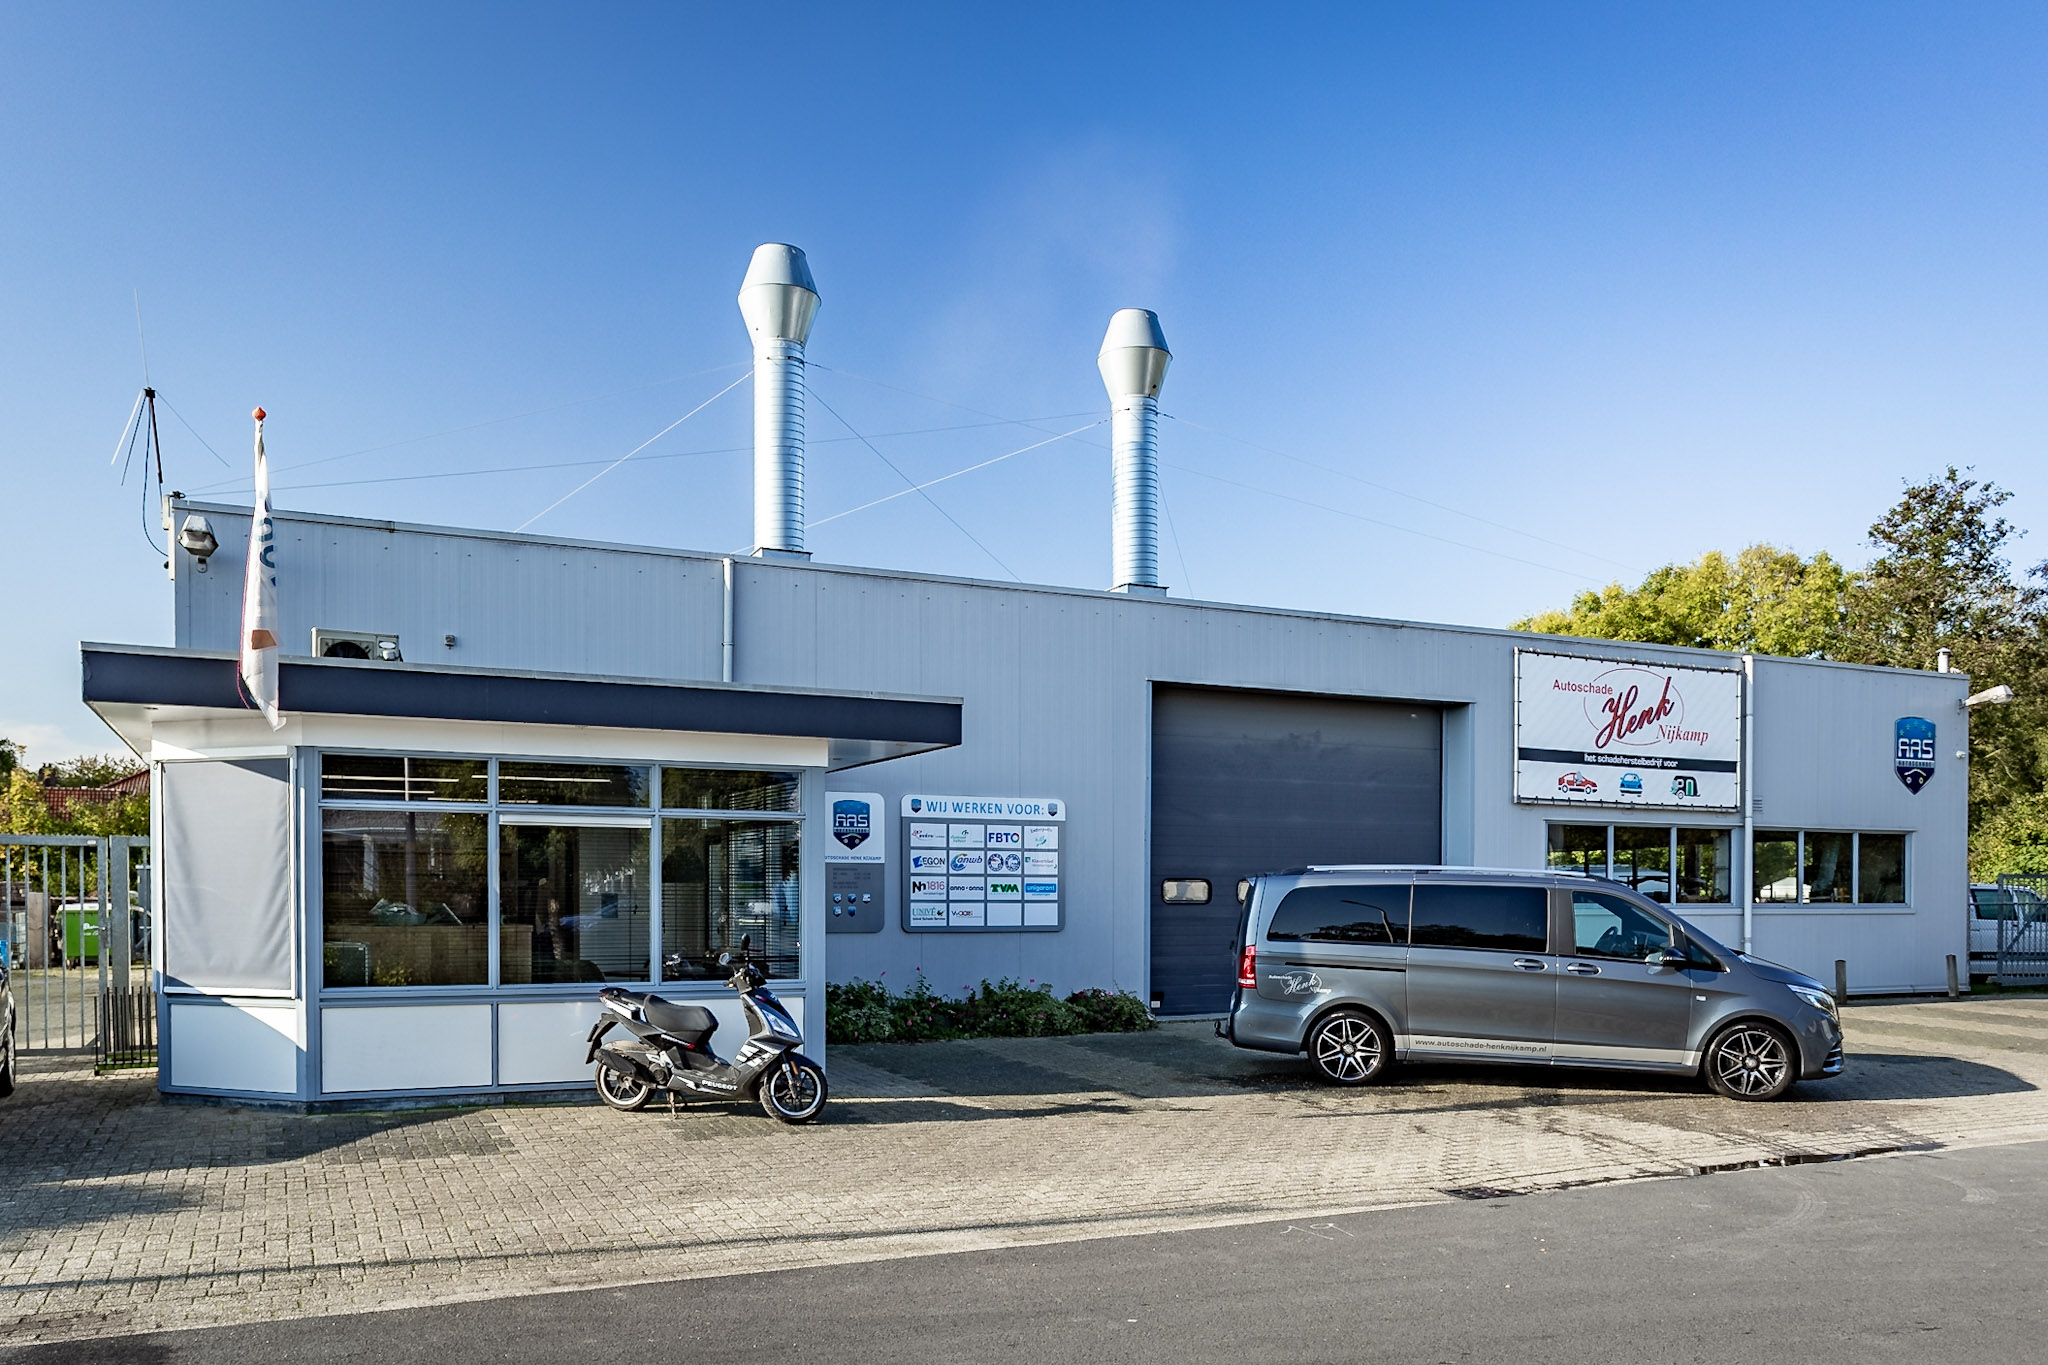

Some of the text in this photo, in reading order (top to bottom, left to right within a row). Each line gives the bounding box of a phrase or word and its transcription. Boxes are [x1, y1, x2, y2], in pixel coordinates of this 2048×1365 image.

[1552, 679, 1614, 695] Autoschade
[1594, 676, 1675, 749] Henk
[1656, 724, 1709, 746] Nijkamp
[1898, 738, 1933, 759] AAS
[1584, 753, 1679, 769] het schadeherstelbedrijf voor
[926, 800, 1045, 815] WIJ WERKEN VOOR:
[835, 813, 869, 827] AAS
[988, 832, 1020, 843] FBTO
[990, 883, 1020, 893] TVM
[1284, 973, 1318, 996] Henk
[1415, 1038, 1548, 1053] www.autoschade-henknijkamp.nl
[702, 1079, 738, 1091] PEUGEOT
